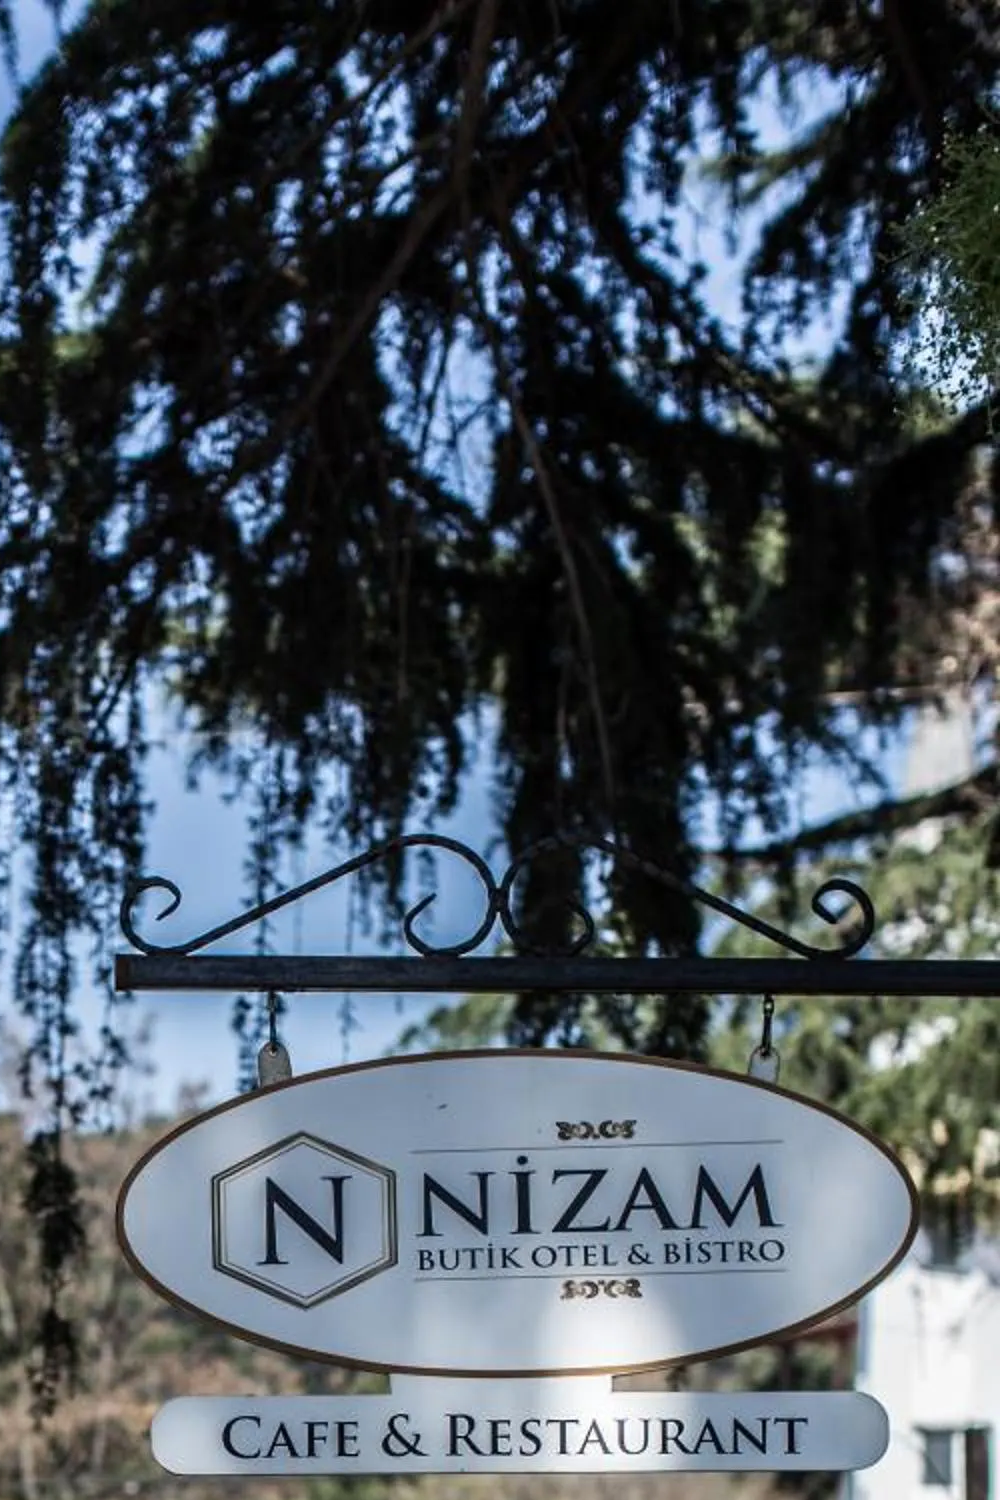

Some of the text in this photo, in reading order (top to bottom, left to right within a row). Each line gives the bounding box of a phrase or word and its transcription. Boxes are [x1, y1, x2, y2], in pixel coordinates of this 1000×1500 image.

[256, 1174, 354, 1266] N
[415, 1155, 785, 1237] NİZAM
[418, 1237, 785, 1271] BUTİK OTEL & BİSTRO
[222, 1412, 809, 1460] CAFE & RESTAURANT
